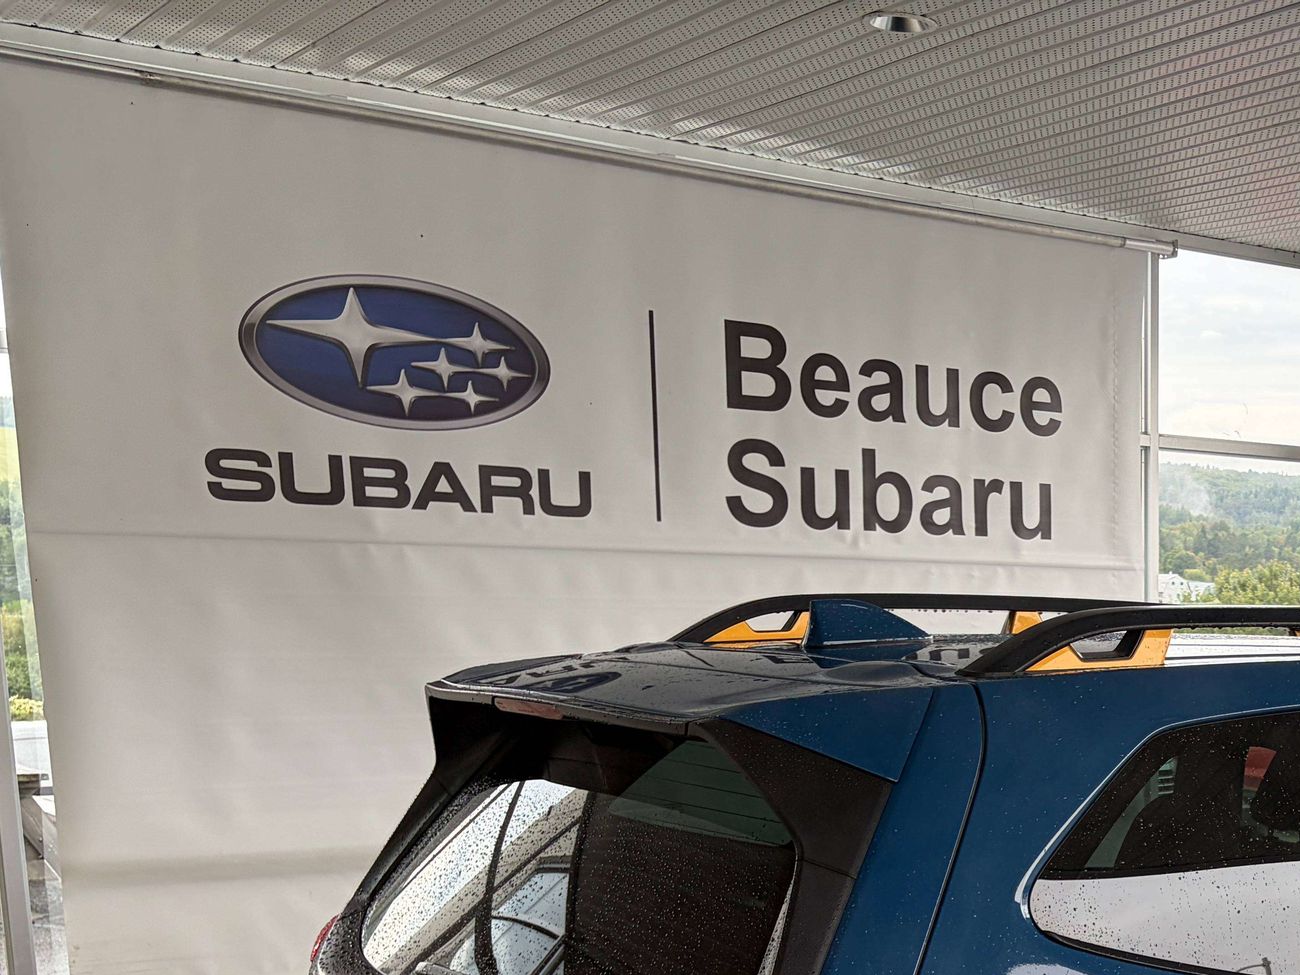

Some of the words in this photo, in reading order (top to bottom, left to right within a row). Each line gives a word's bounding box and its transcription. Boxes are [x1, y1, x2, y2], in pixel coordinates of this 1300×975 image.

[724, 319, 1063, 437] Beauce
[205, 447, 592, 518] SUBARU
[725, 438, 1053, 540] Subaru
